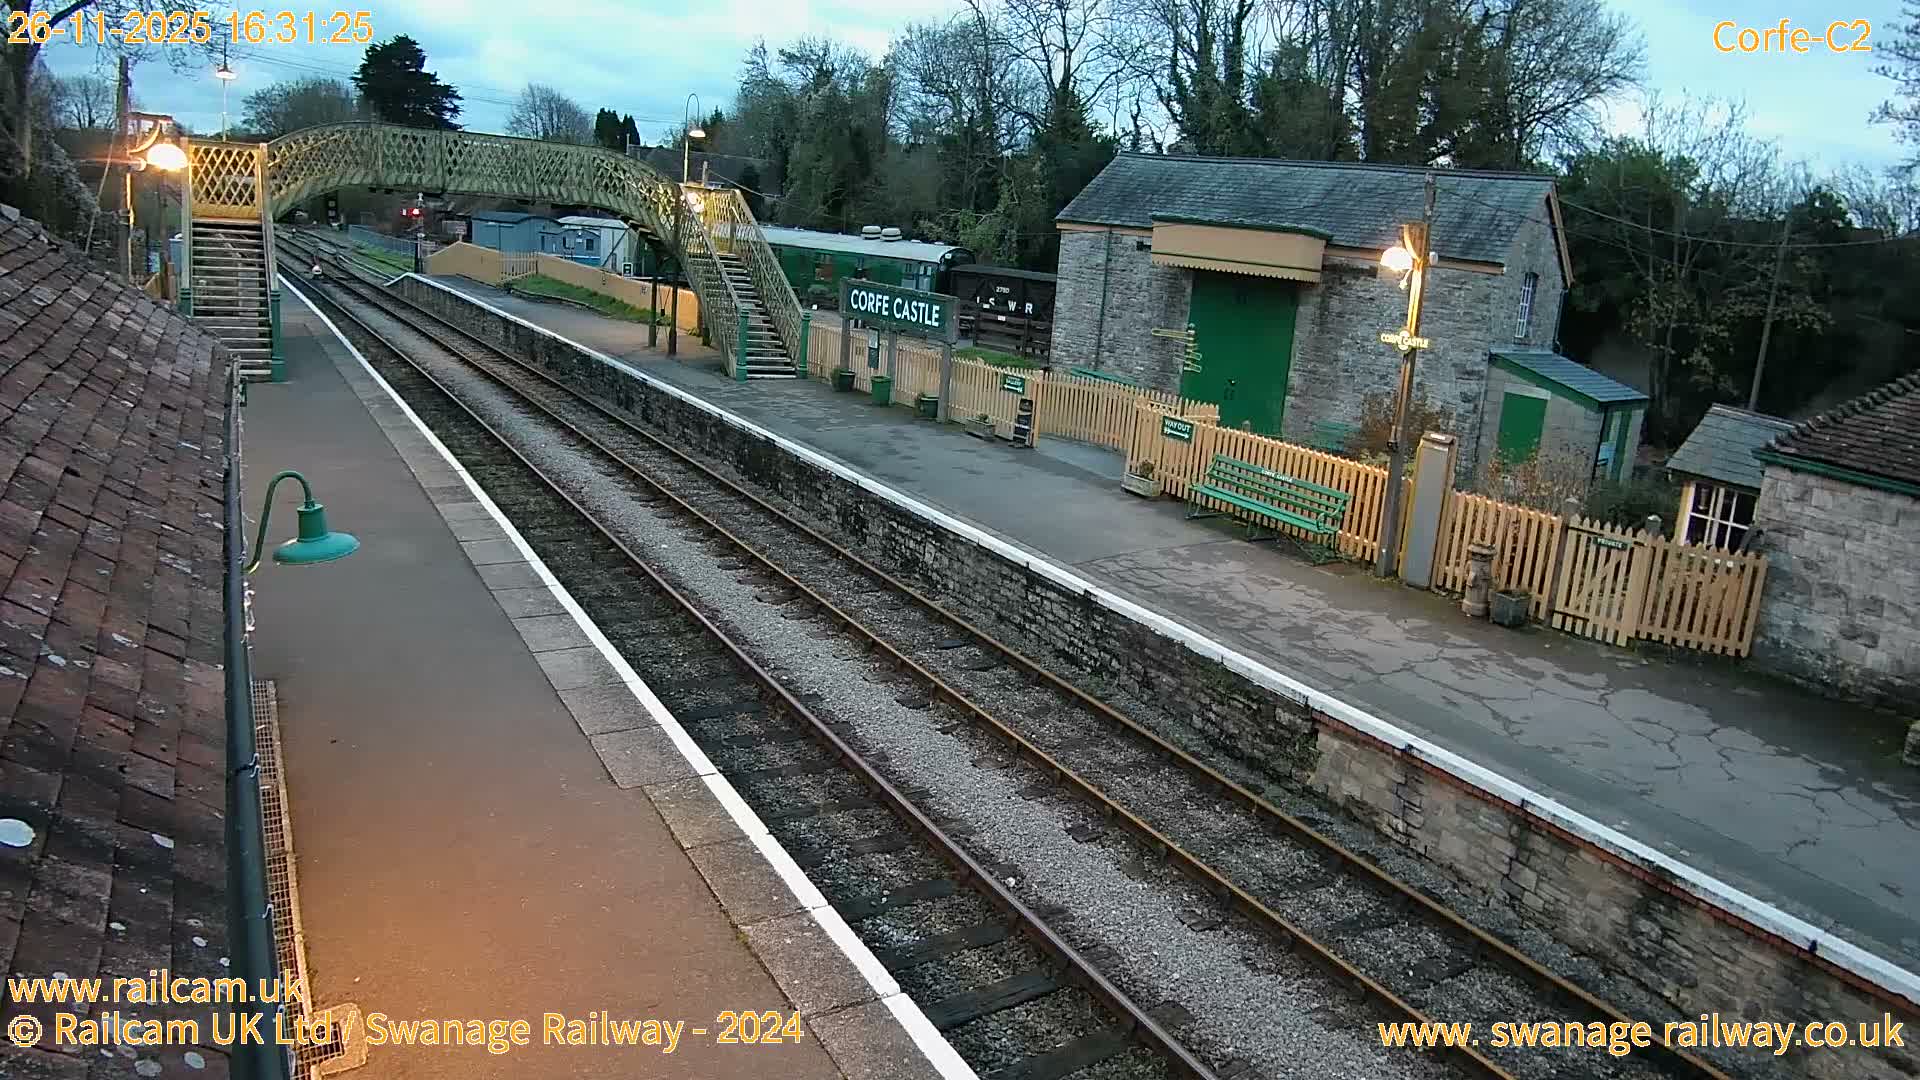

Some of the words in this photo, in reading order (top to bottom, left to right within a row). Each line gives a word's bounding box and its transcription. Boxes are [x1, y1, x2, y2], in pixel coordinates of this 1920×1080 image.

[850, 289, 889, 316] CORFE
[893, 298, 940, 327] CASTLE
[1164, 419, 1177, 428] WAY
[1177, 423, 1191, 432] OUT
